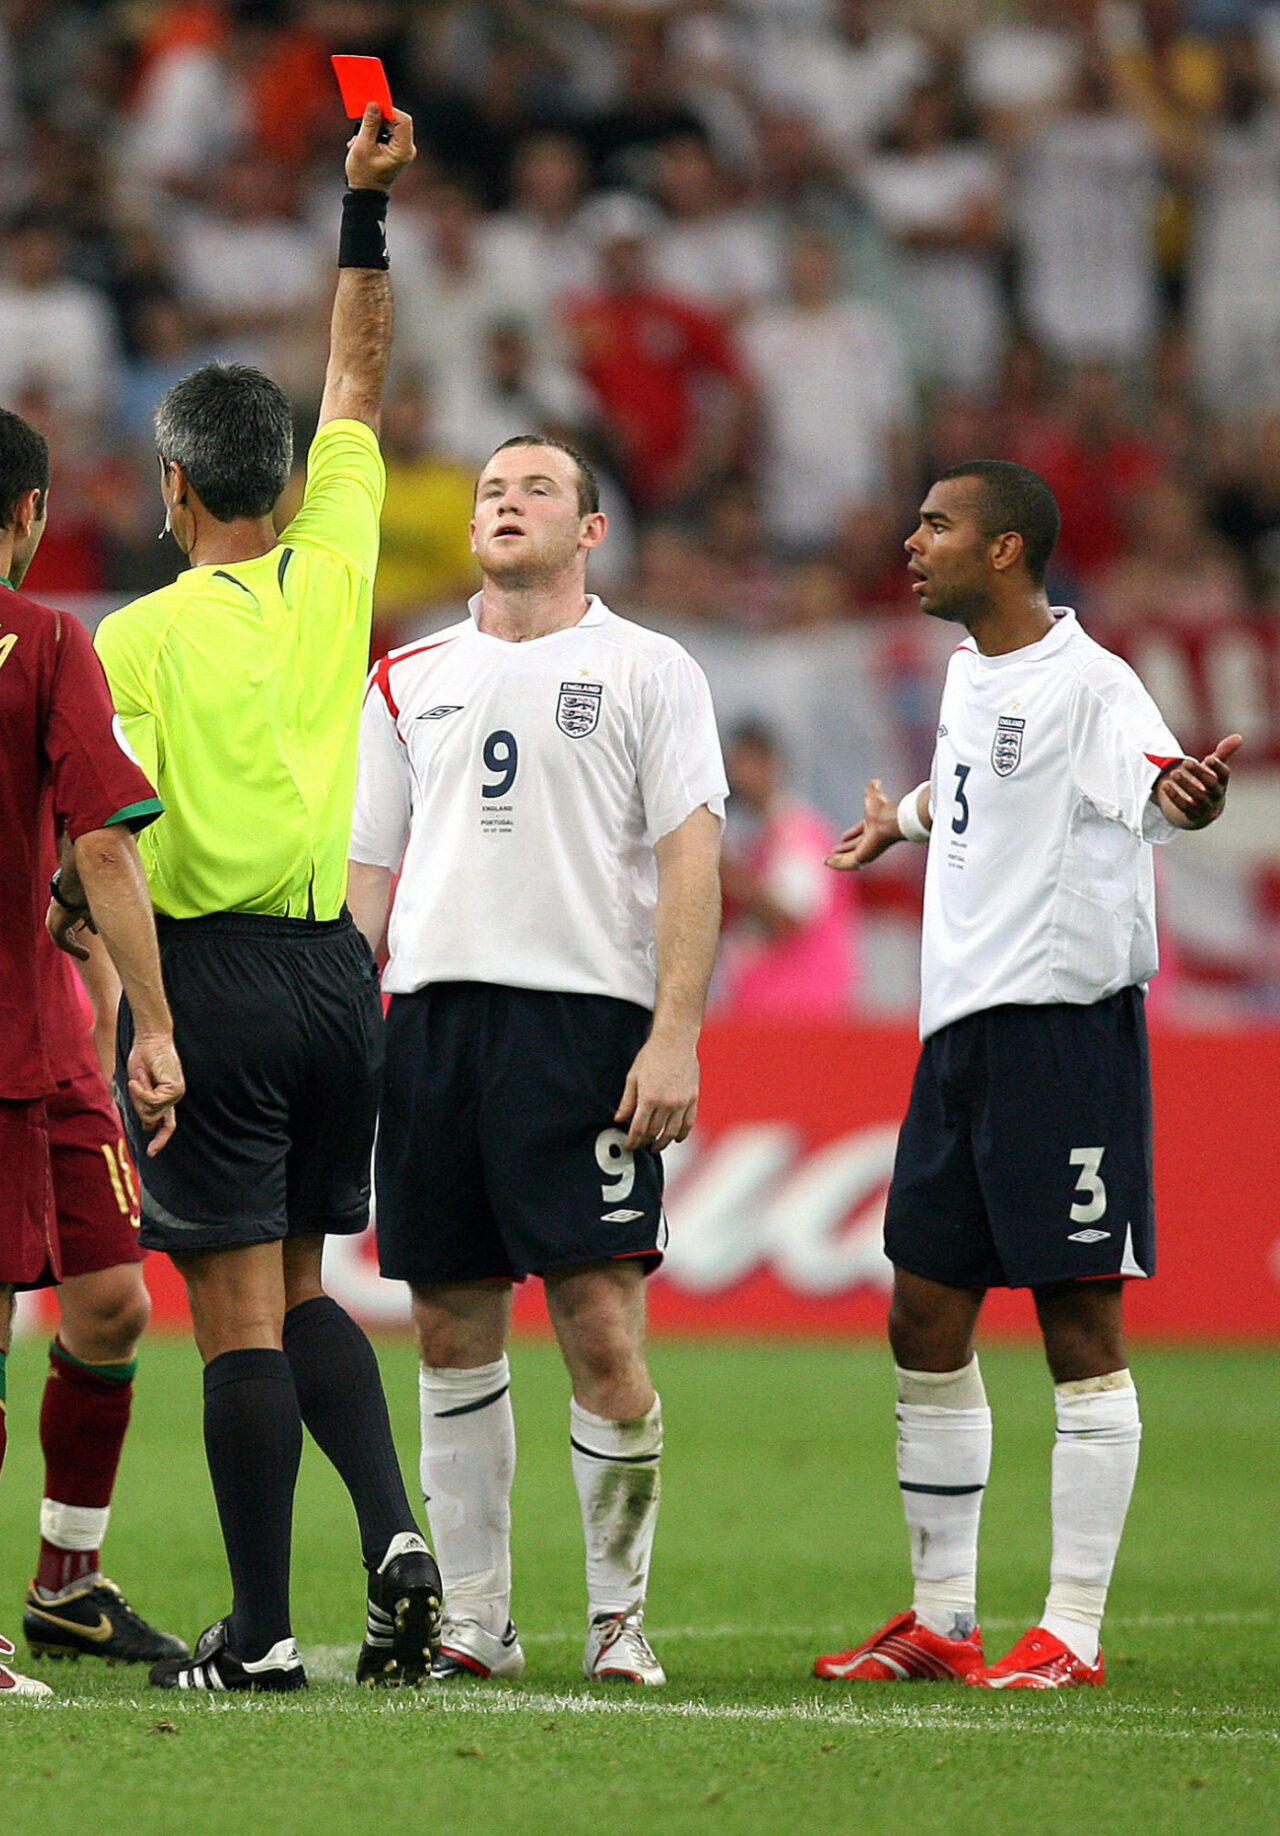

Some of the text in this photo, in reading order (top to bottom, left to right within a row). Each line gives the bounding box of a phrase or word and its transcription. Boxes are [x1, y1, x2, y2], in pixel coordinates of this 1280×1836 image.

[481, 729, 519, 799] 9
[951, 762, 972, 835] 3
[595, 1131, 636, 1203] 9
[1068, 1147, 1108, 1223] 3
